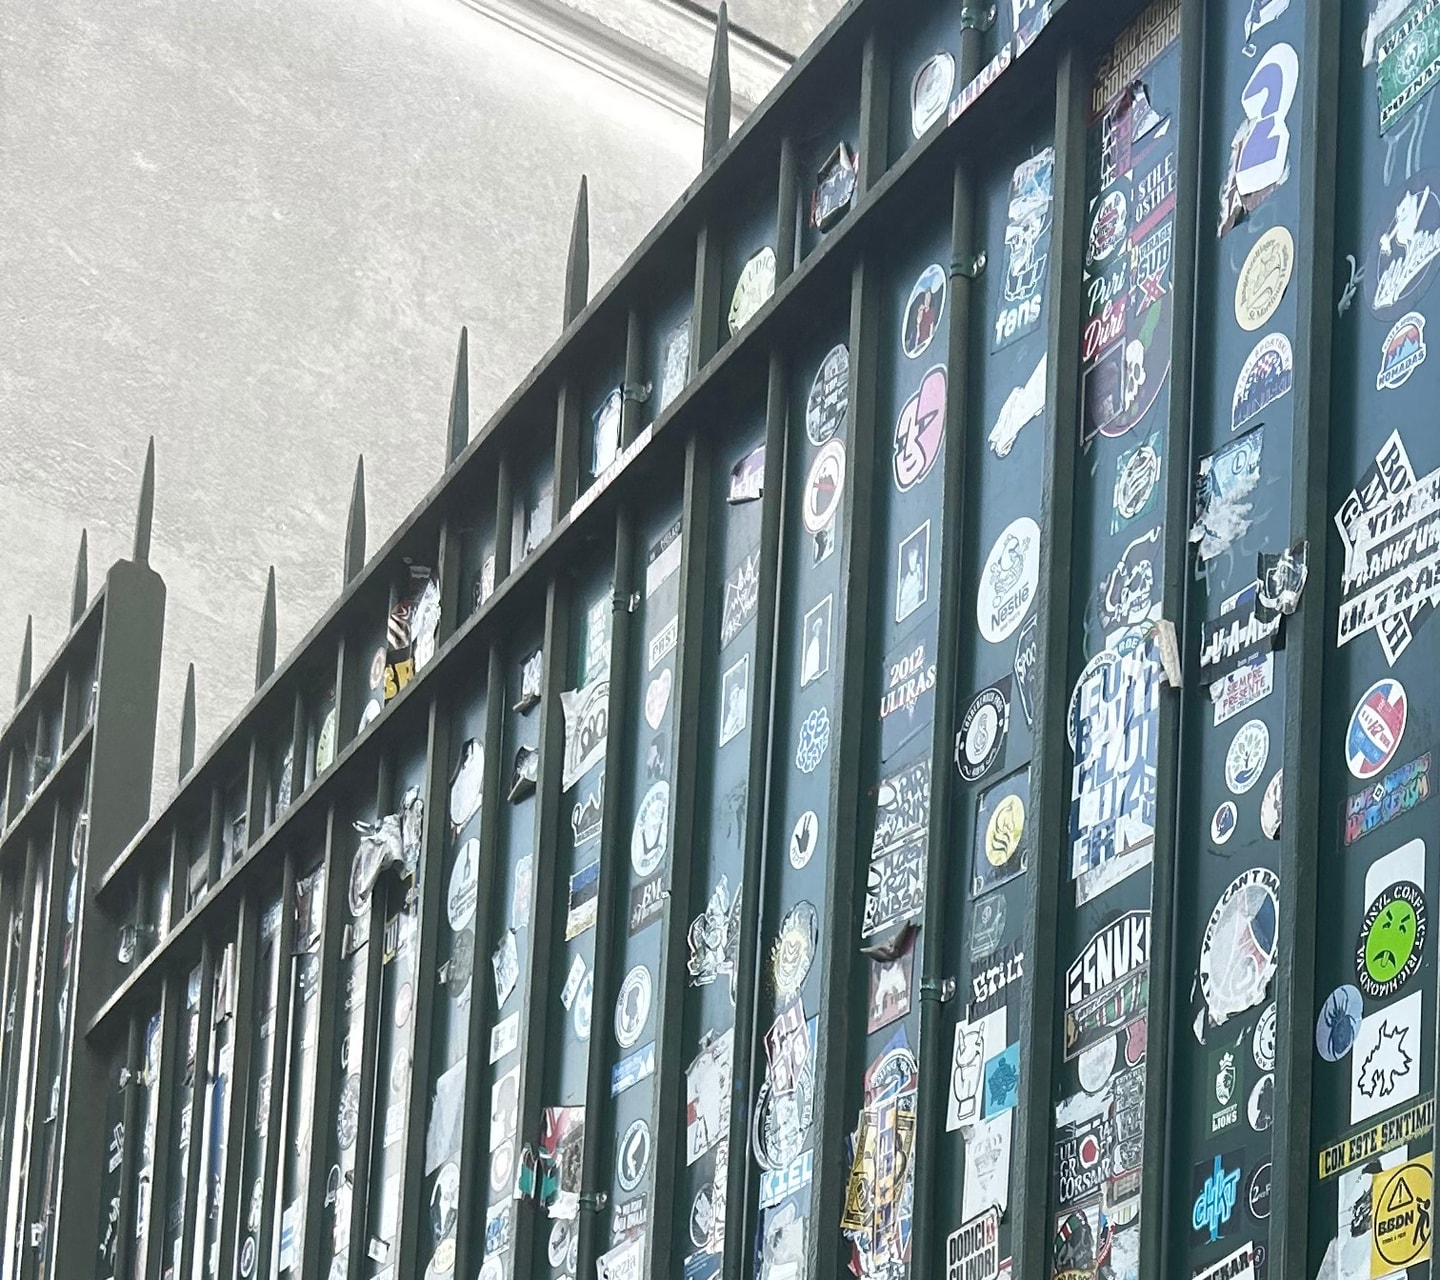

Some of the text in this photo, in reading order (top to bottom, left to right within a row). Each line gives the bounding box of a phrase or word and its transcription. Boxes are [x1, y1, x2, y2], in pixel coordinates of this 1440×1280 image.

[1137, 152, 1174, 201] STILE
[1135, 178, 1175, 224] OSTILE
[995, 297, 1042, 345] fans
[889, 645, 924, 687] 2012
[879, 664, 937, 719] ULTRAS
[1212, 1110, 1239, 1133] LIONS
[1324, 1107, 1435, 1172] CON ESTE SENTIMI
[948, 1224, 986, 1266] DODICI
